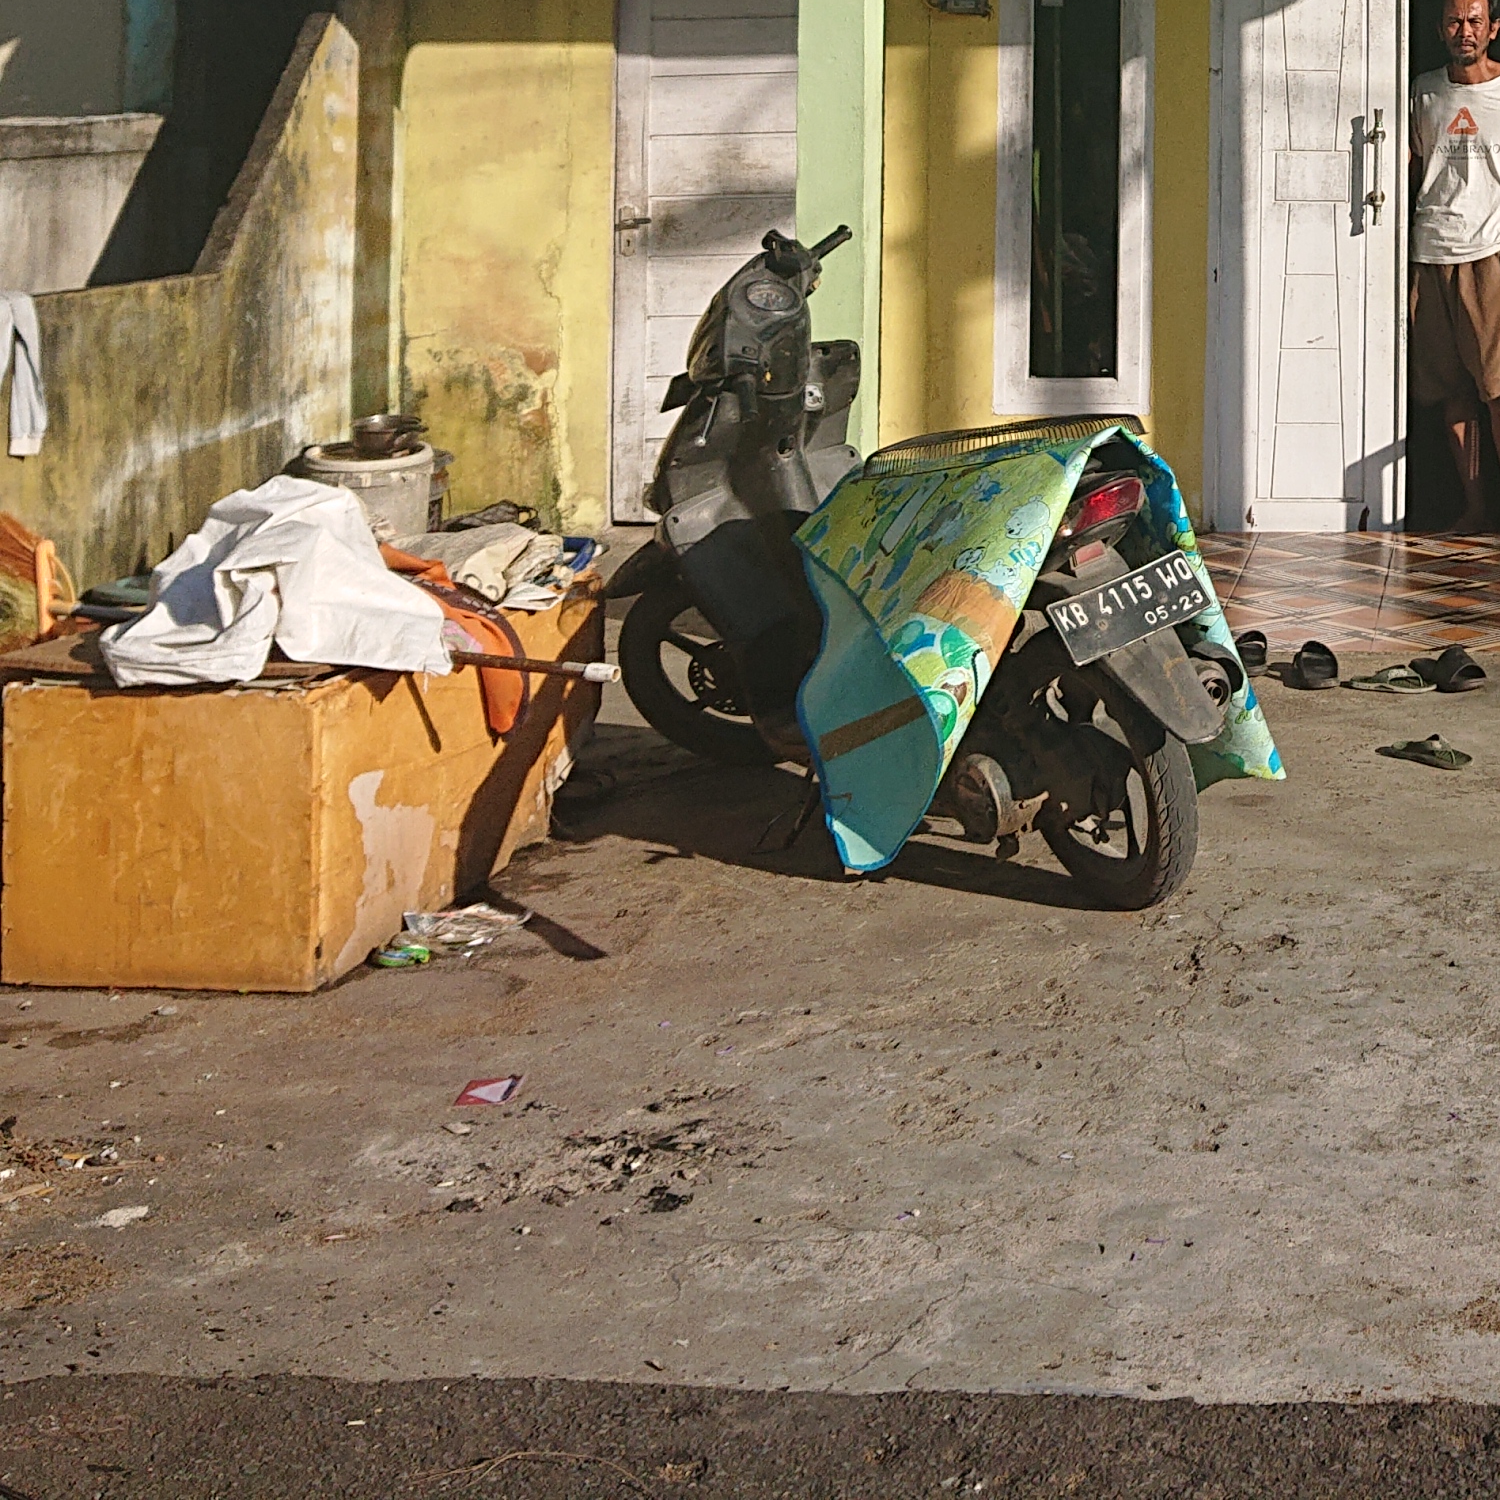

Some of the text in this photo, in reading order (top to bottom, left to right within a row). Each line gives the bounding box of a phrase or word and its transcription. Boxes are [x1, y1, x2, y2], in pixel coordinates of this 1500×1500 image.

[1463, 143, 1500, 154] BRAVO
[1054, 602, 1089, 631] KB
[1098, 575, 1152, 615] 4115
